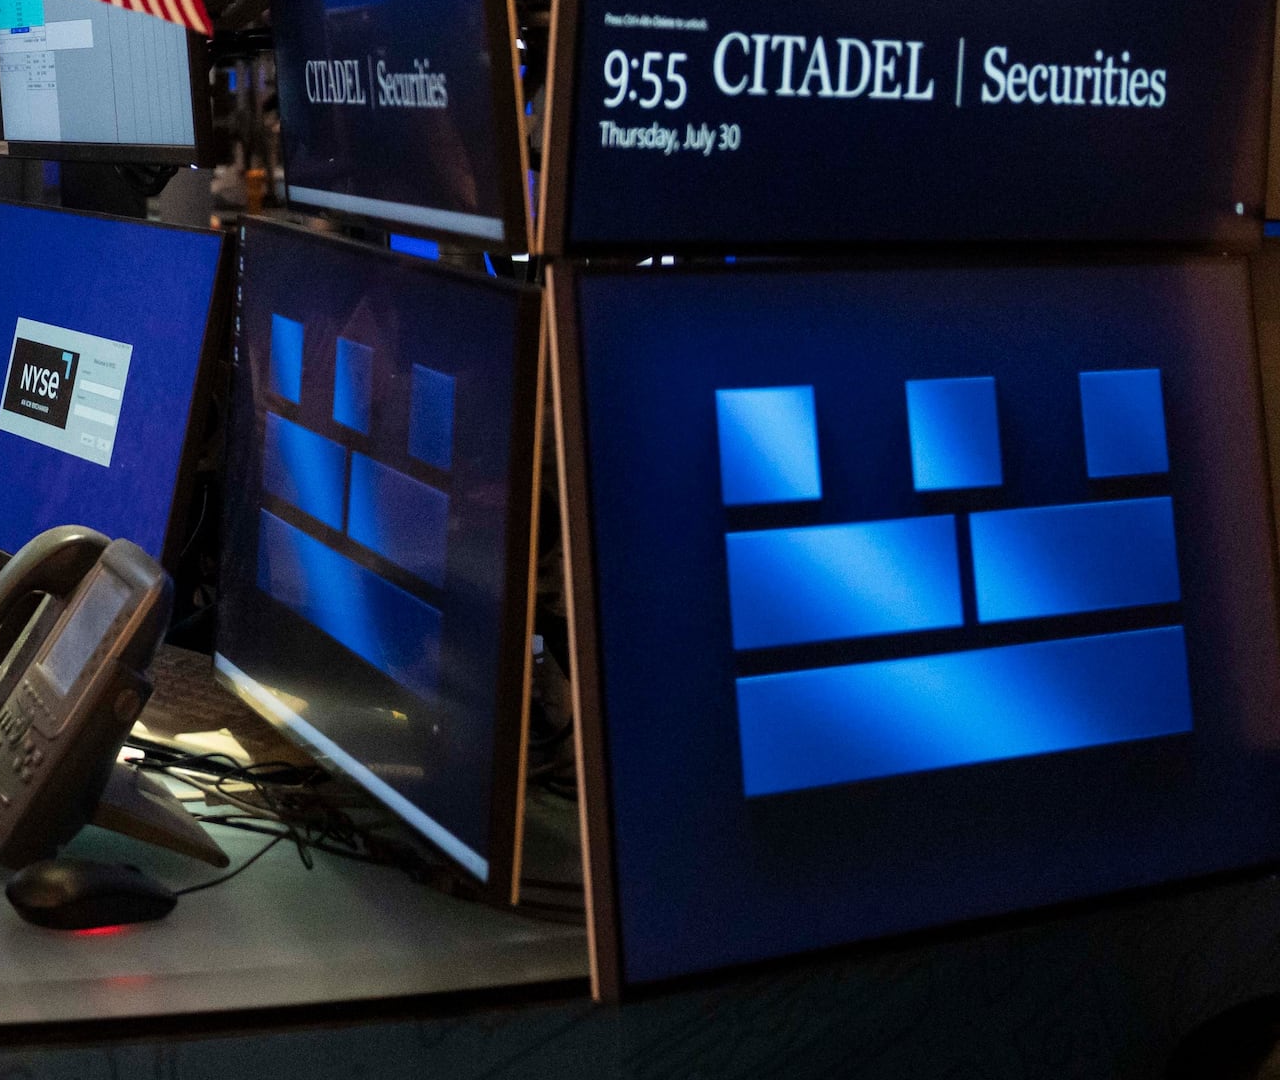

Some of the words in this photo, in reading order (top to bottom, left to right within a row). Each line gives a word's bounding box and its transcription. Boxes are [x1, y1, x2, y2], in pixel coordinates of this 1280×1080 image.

[304, 59, 366, 107] CITADEL
[376, 58, 449, 109] Securities
[603, 49, 688, 110] 9:55
[713, 32, 934, 101] CITADEL
[980, 45, 1167, 108] Securities
[600, 120, 680, 156] Thursday,
[683, 122, 717, 157] July
[718, 123, 741, 151] 30
